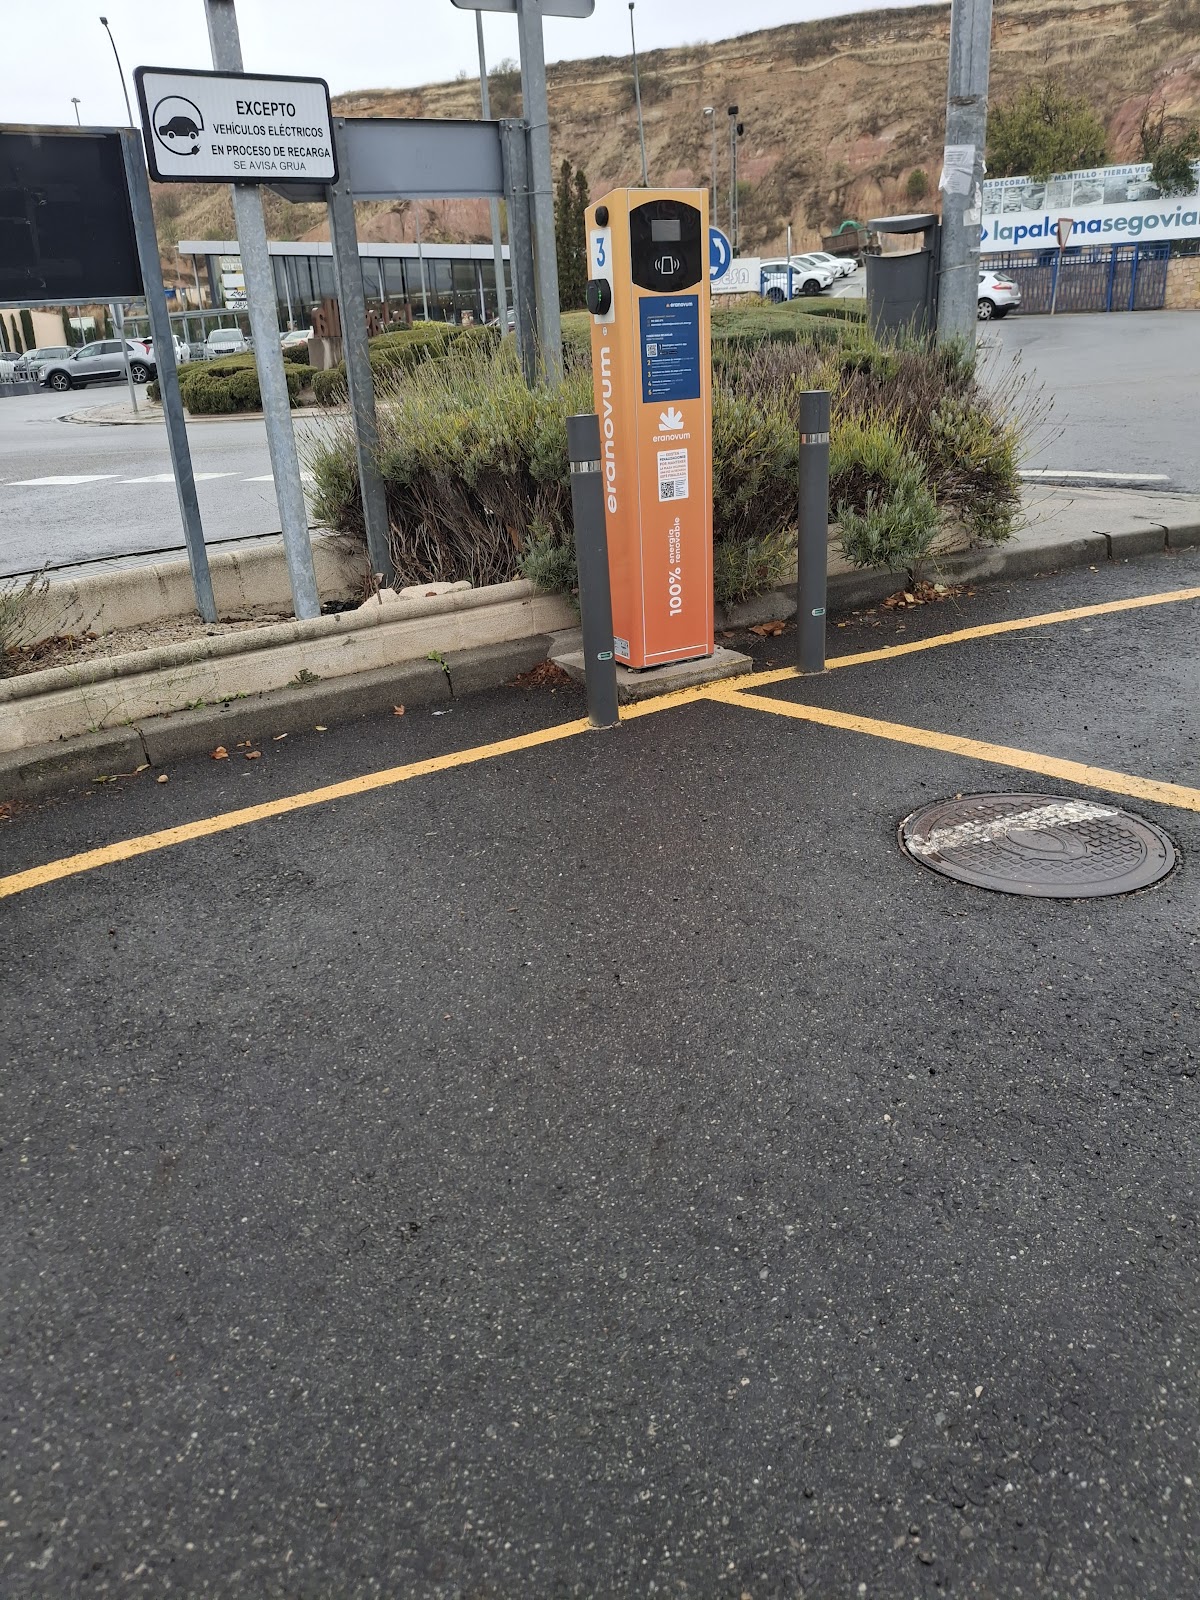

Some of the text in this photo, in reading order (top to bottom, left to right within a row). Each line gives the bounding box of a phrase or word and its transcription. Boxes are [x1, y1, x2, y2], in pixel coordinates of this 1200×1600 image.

[236, 100, 296, 117] EXCEPTO
[213, 122, 323, 138] VEHÍCULOS ELÉCTRICOS
[211, 145, 331, 158] EN PROCESO DE RECARGA
[233, 161, 306, 171] SE AVISA GRUA
[1054, 172, 1097, 181] MANTILLO
[1103, 168, 1133, 177] TIERRA
[1134, 166, 1152, 174] VEG
[994, 205, 1200, 245] lapalomasegovia
[595, 237, 606, 267] 3
[600, 346, 618, 514] eranovum
[652, 433, 691, 442] eranovum
[668, 567, 682, 616] 100%
